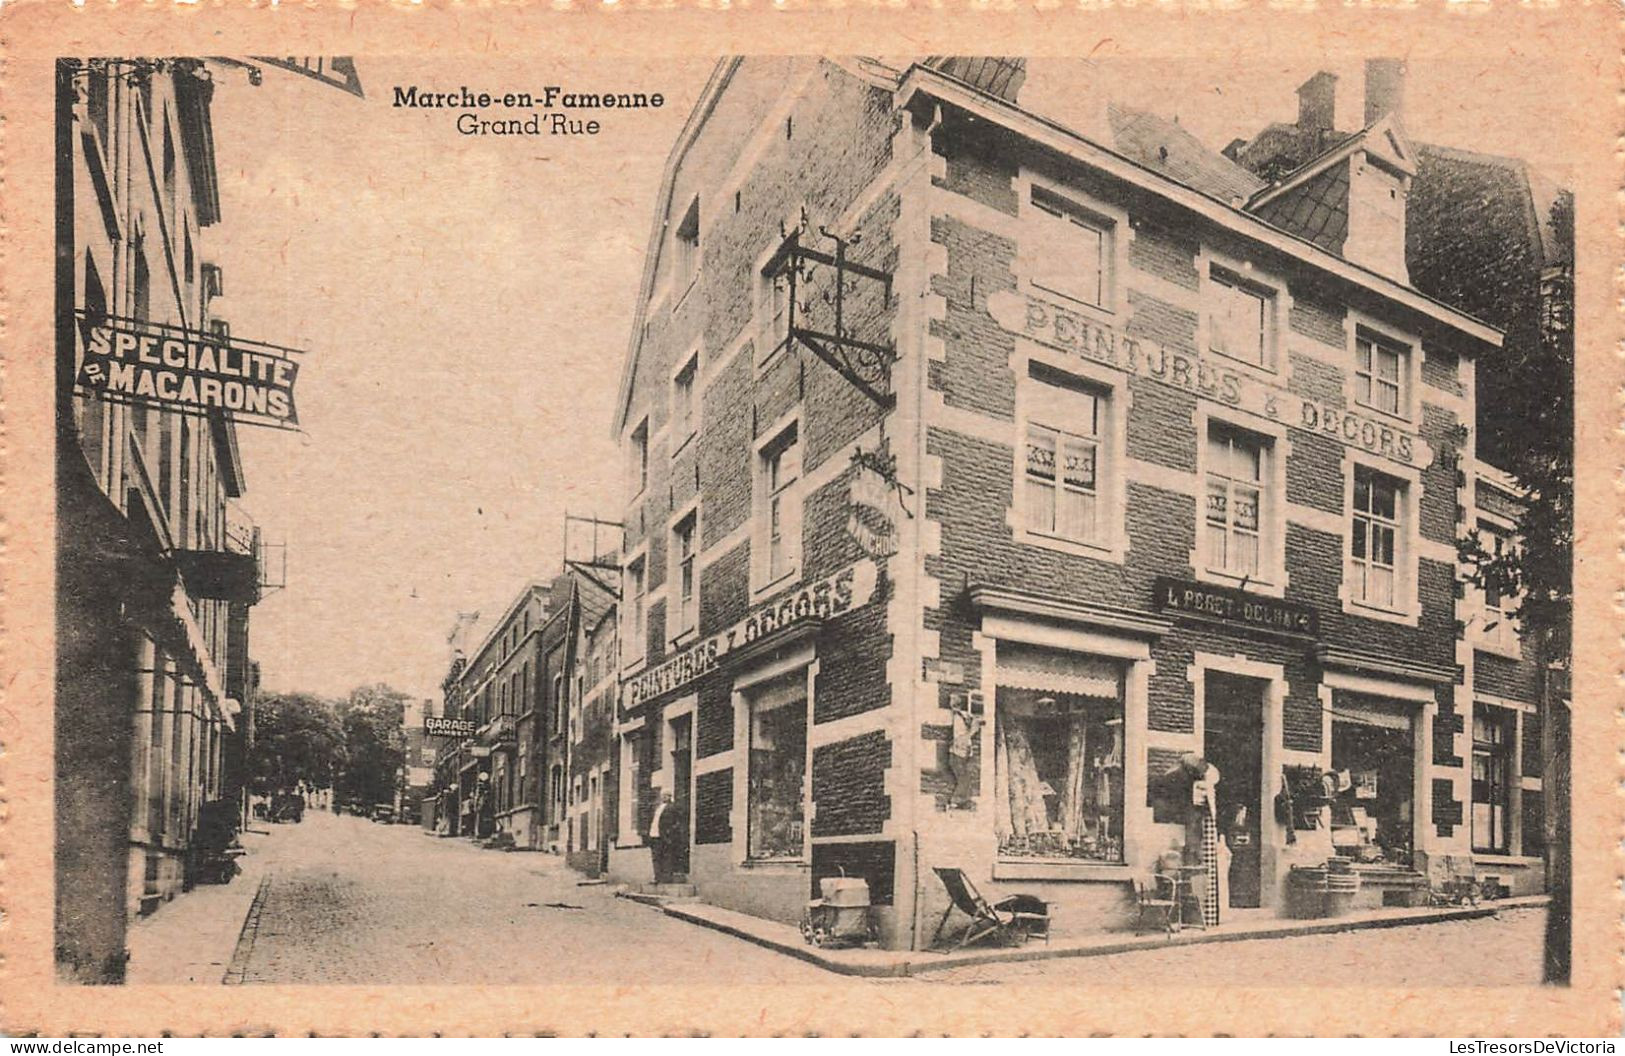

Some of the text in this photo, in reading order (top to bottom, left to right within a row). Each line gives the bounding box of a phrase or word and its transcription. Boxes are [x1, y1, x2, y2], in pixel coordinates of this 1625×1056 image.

[89, 326, 293, 388] SPECIALITE
[1025, 301, 1242, 404] PEINTURES
[1302, 400, 1413, 462] DECORS
[84, 360, 290, 418] DE MACARONS
[631, 639, 719, 705] PEINTURES
[426, 719, 476, 732] GARAGE
